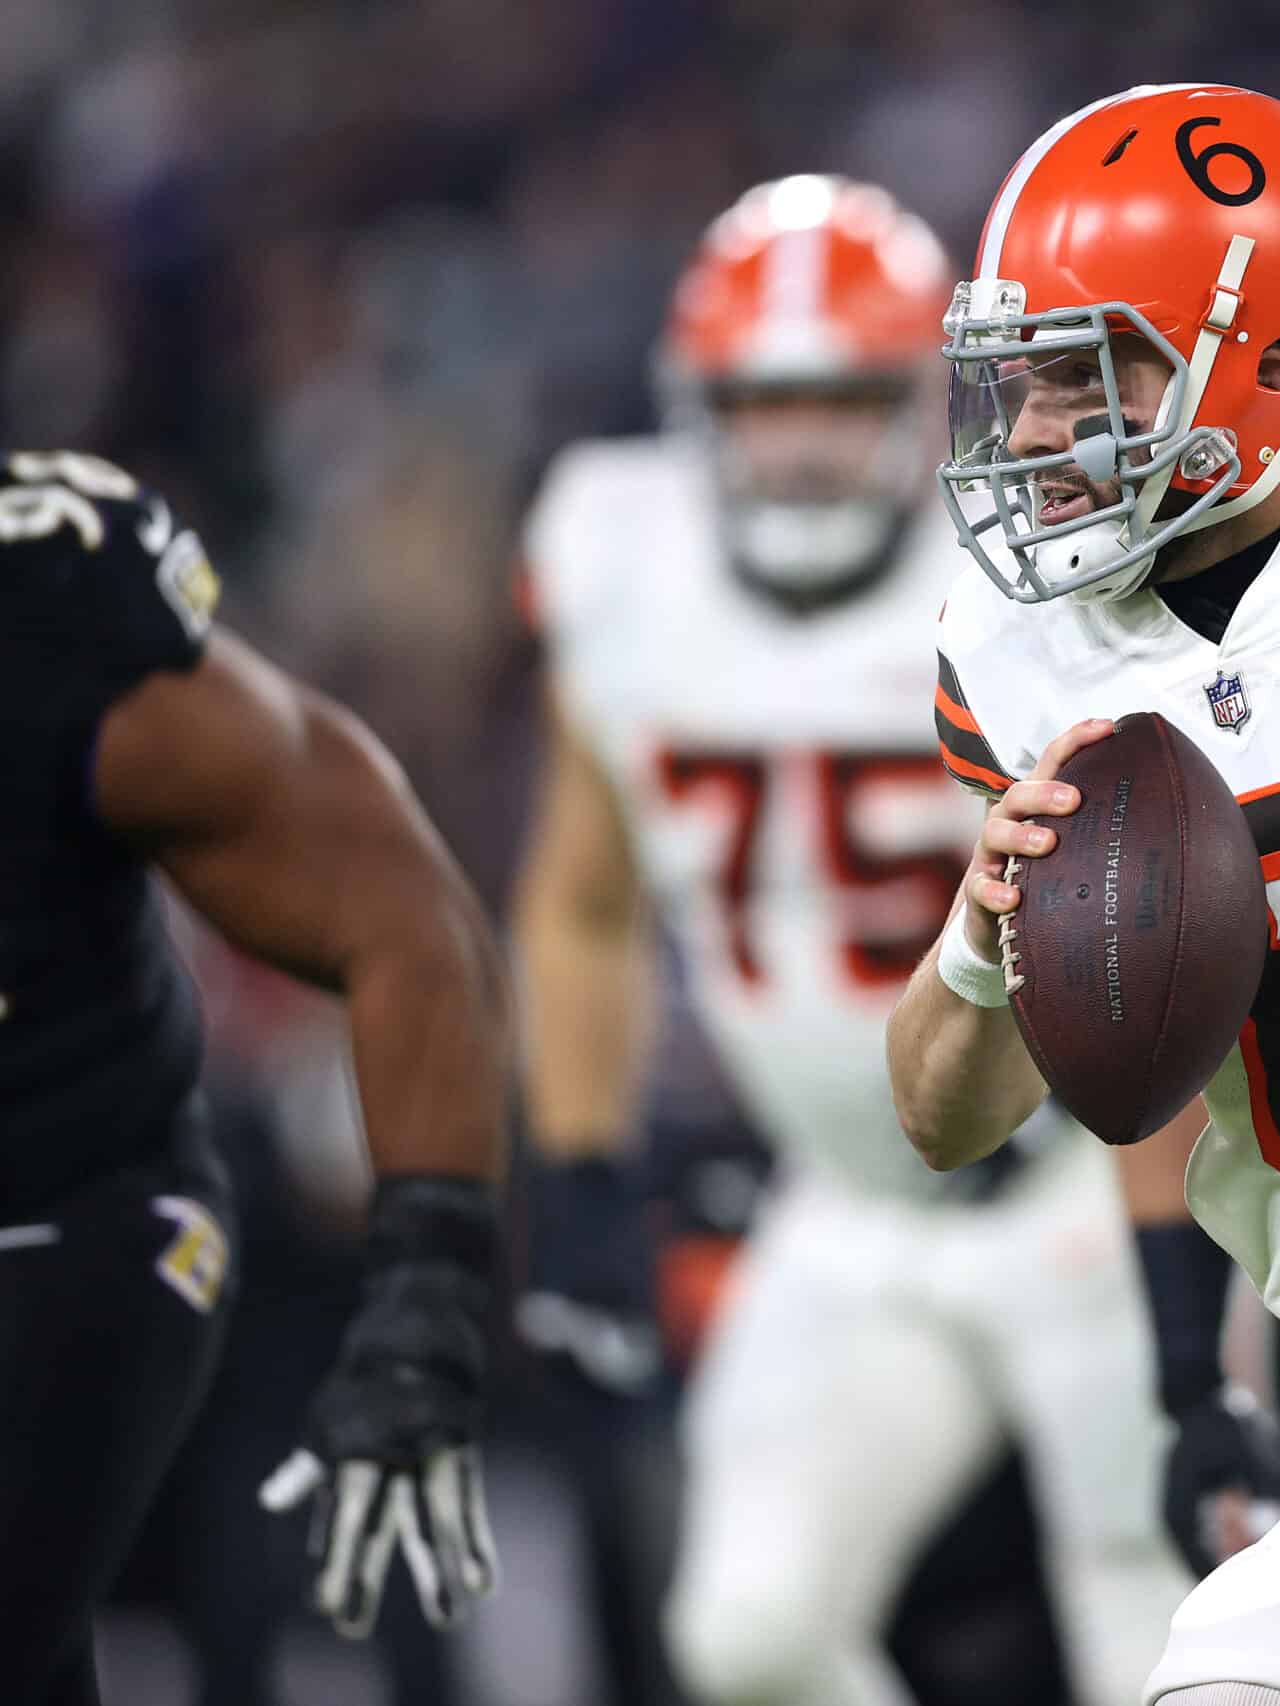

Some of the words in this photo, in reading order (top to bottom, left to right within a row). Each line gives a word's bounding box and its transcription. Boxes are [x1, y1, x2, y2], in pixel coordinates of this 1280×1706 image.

[1175, 116, 1266, 207] 6
[1213, 695, 1245, 724] NFL
[1111, 776, 1132, 832] LEAGUE
[655, 749, 970, 986] 75
[1104, 838, 1121, 926] FOOTBALL
[1105, 933, 1124, 1021] NATIONAL
